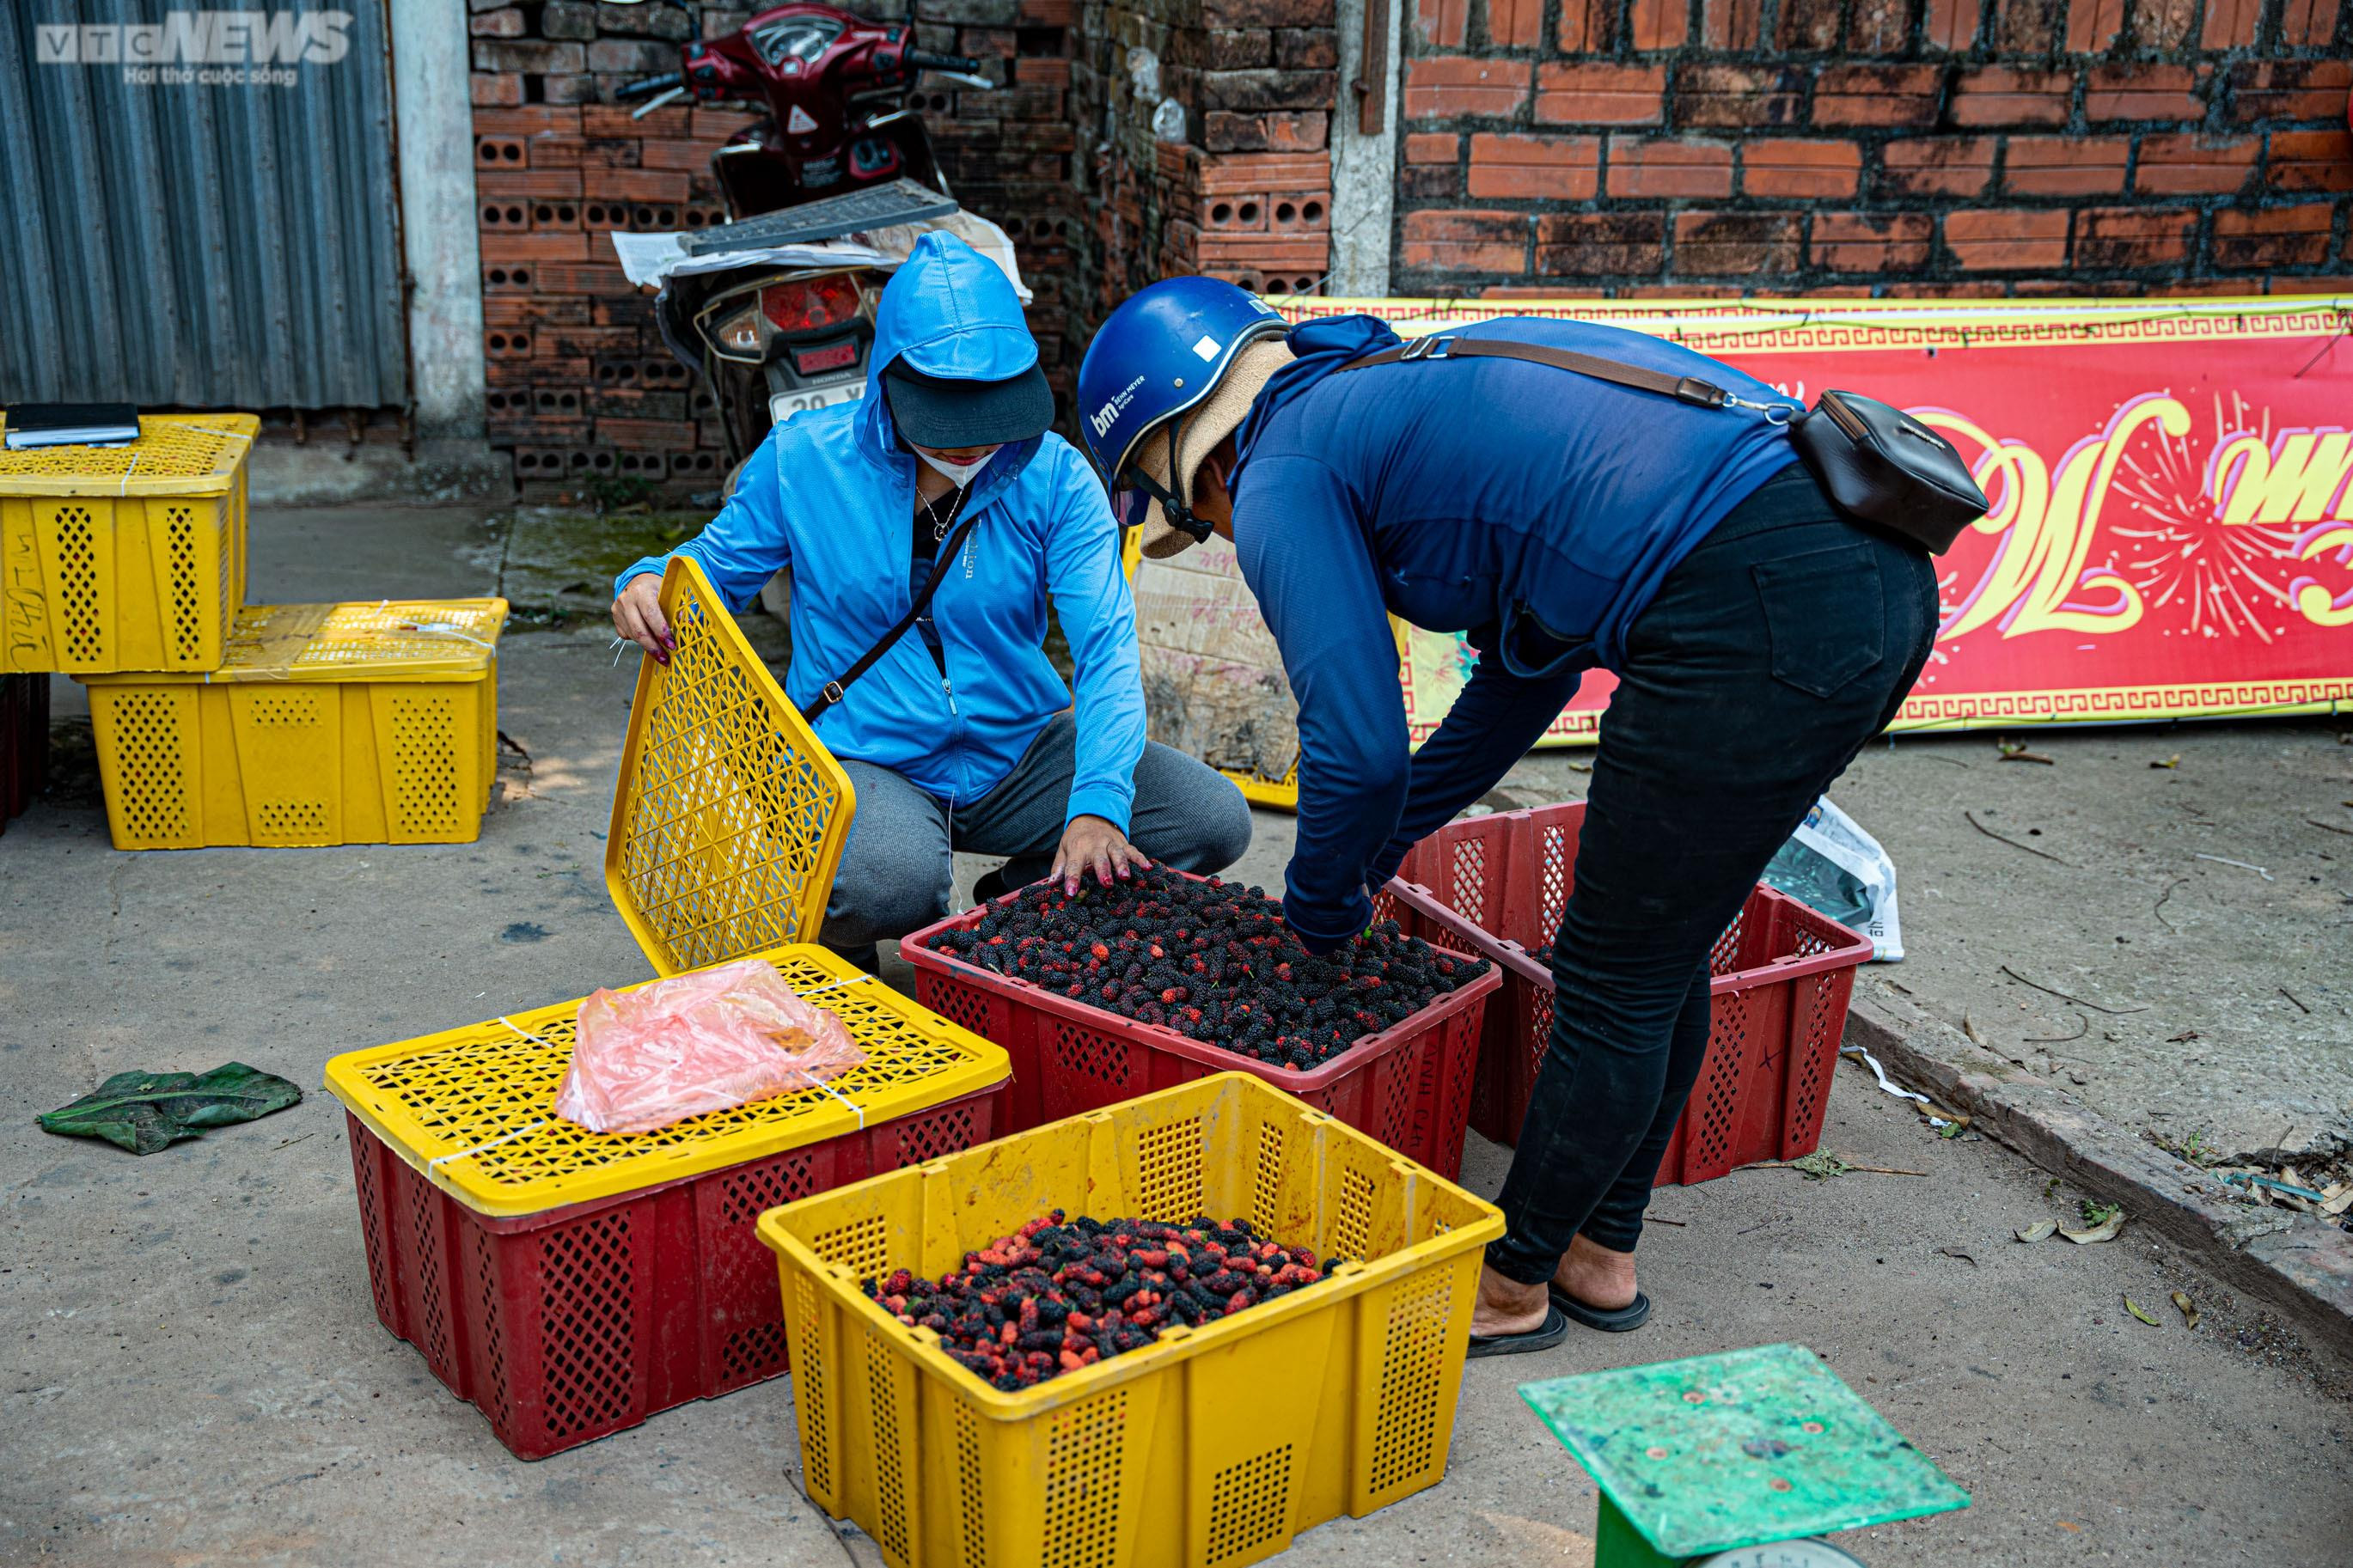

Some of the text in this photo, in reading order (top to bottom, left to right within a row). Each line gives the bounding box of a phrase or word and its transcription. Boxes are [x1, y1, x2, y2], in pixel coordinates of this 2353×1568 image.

[811, 372, 852, 385] HONDA
[1114, 375, 1145, 405] BEHN MEYER
[1090, 402, 1120, 438] bm
